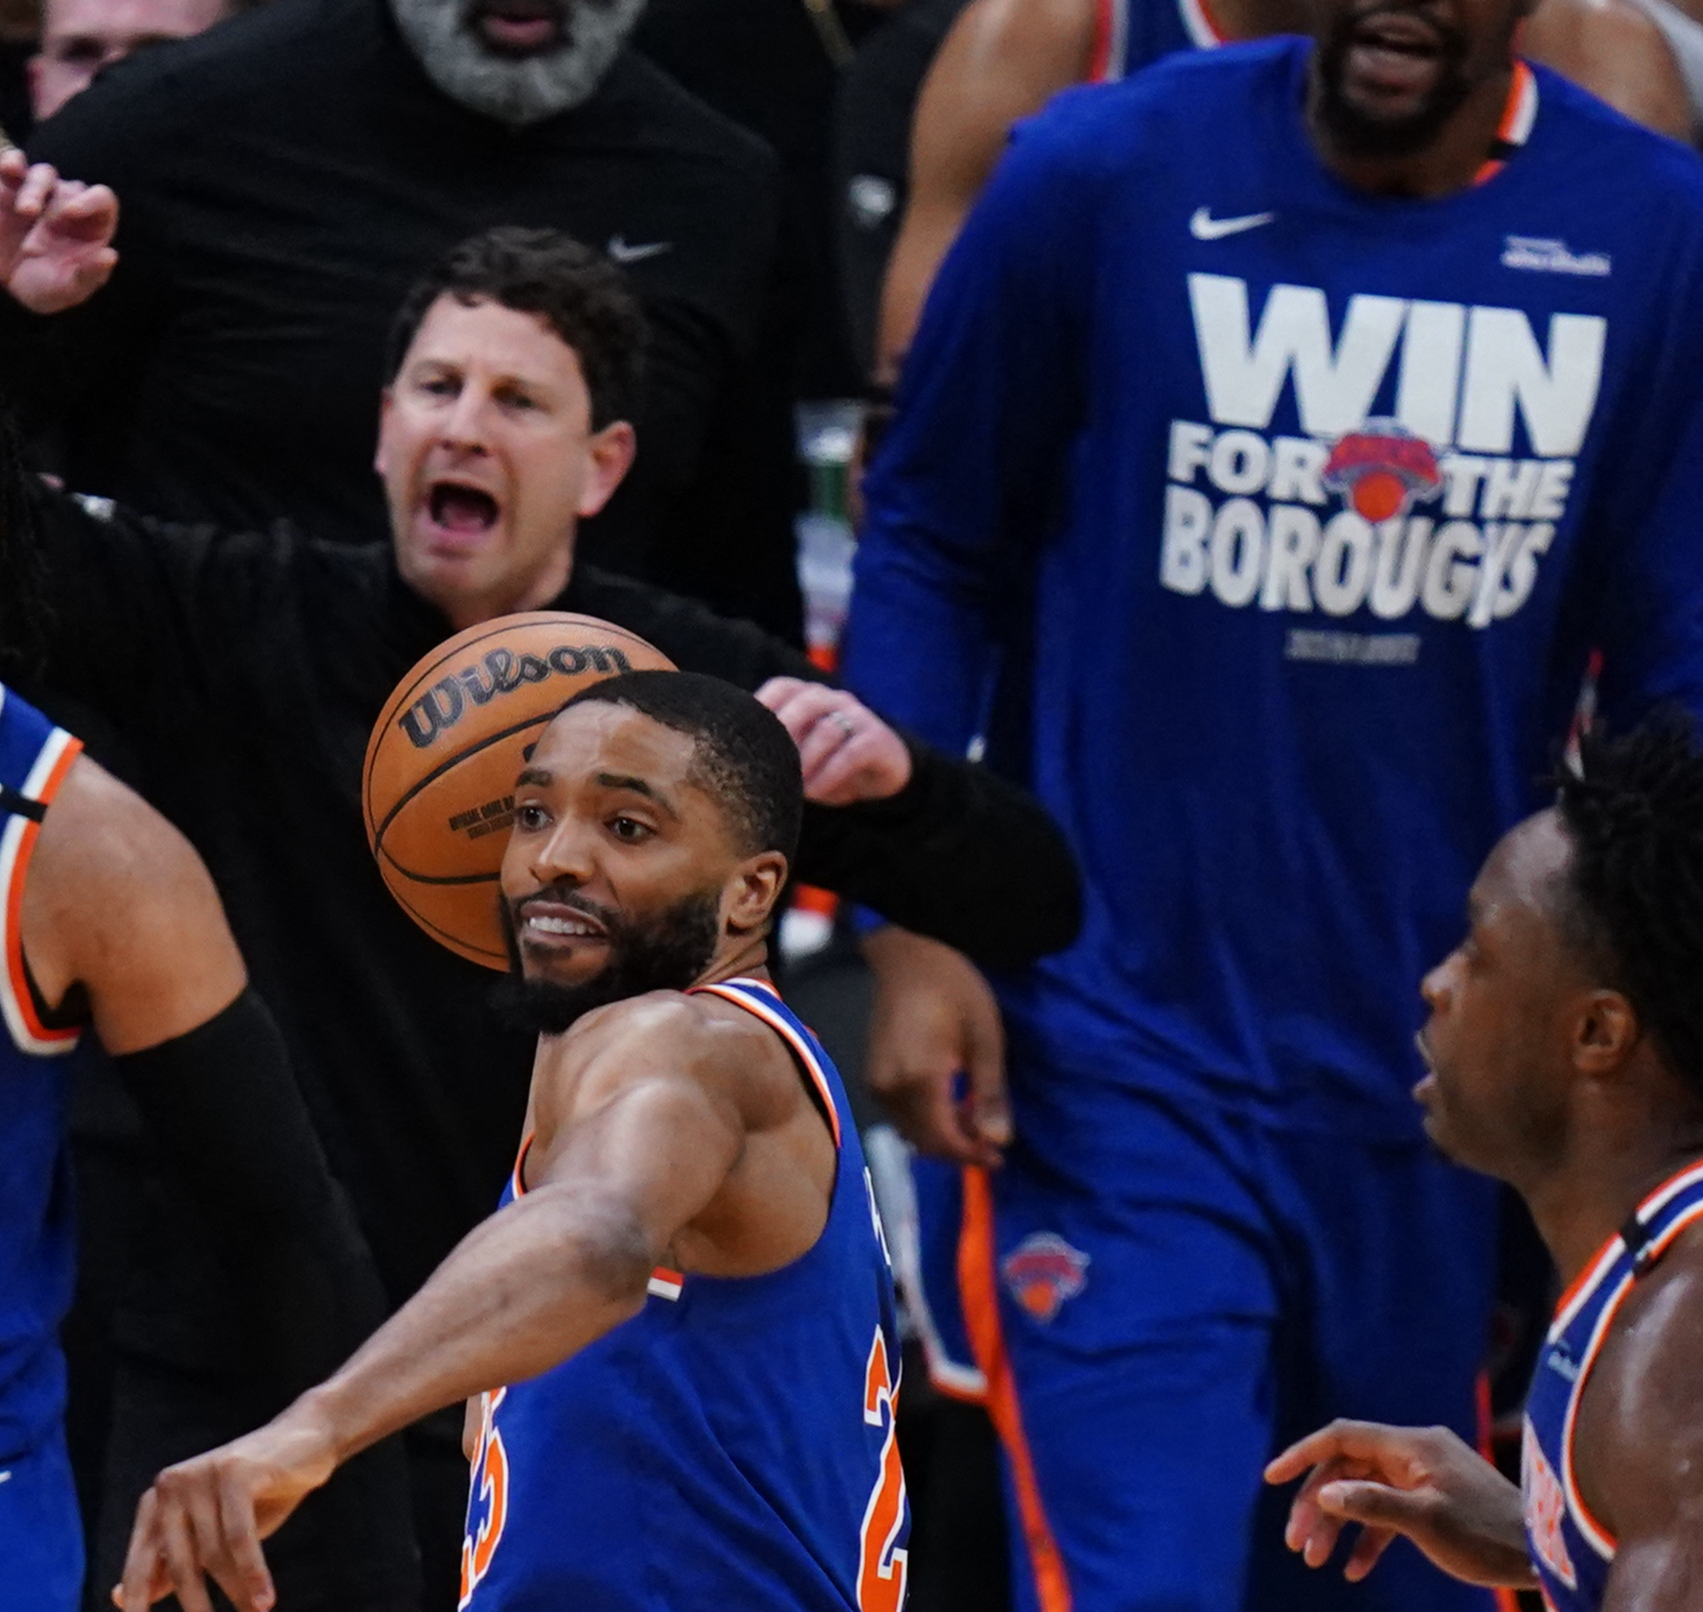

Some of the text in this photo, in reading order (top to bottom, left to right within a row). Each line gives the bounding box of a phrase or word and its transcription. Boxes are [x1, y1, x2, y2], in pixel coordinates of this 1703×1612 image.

[1187, 272, 1607, 457] WIN
[1169, 418, 1330, 505] FOR
[1440, 453, 1575, 520] THE
[398, 645, 632, 748] Wilson
